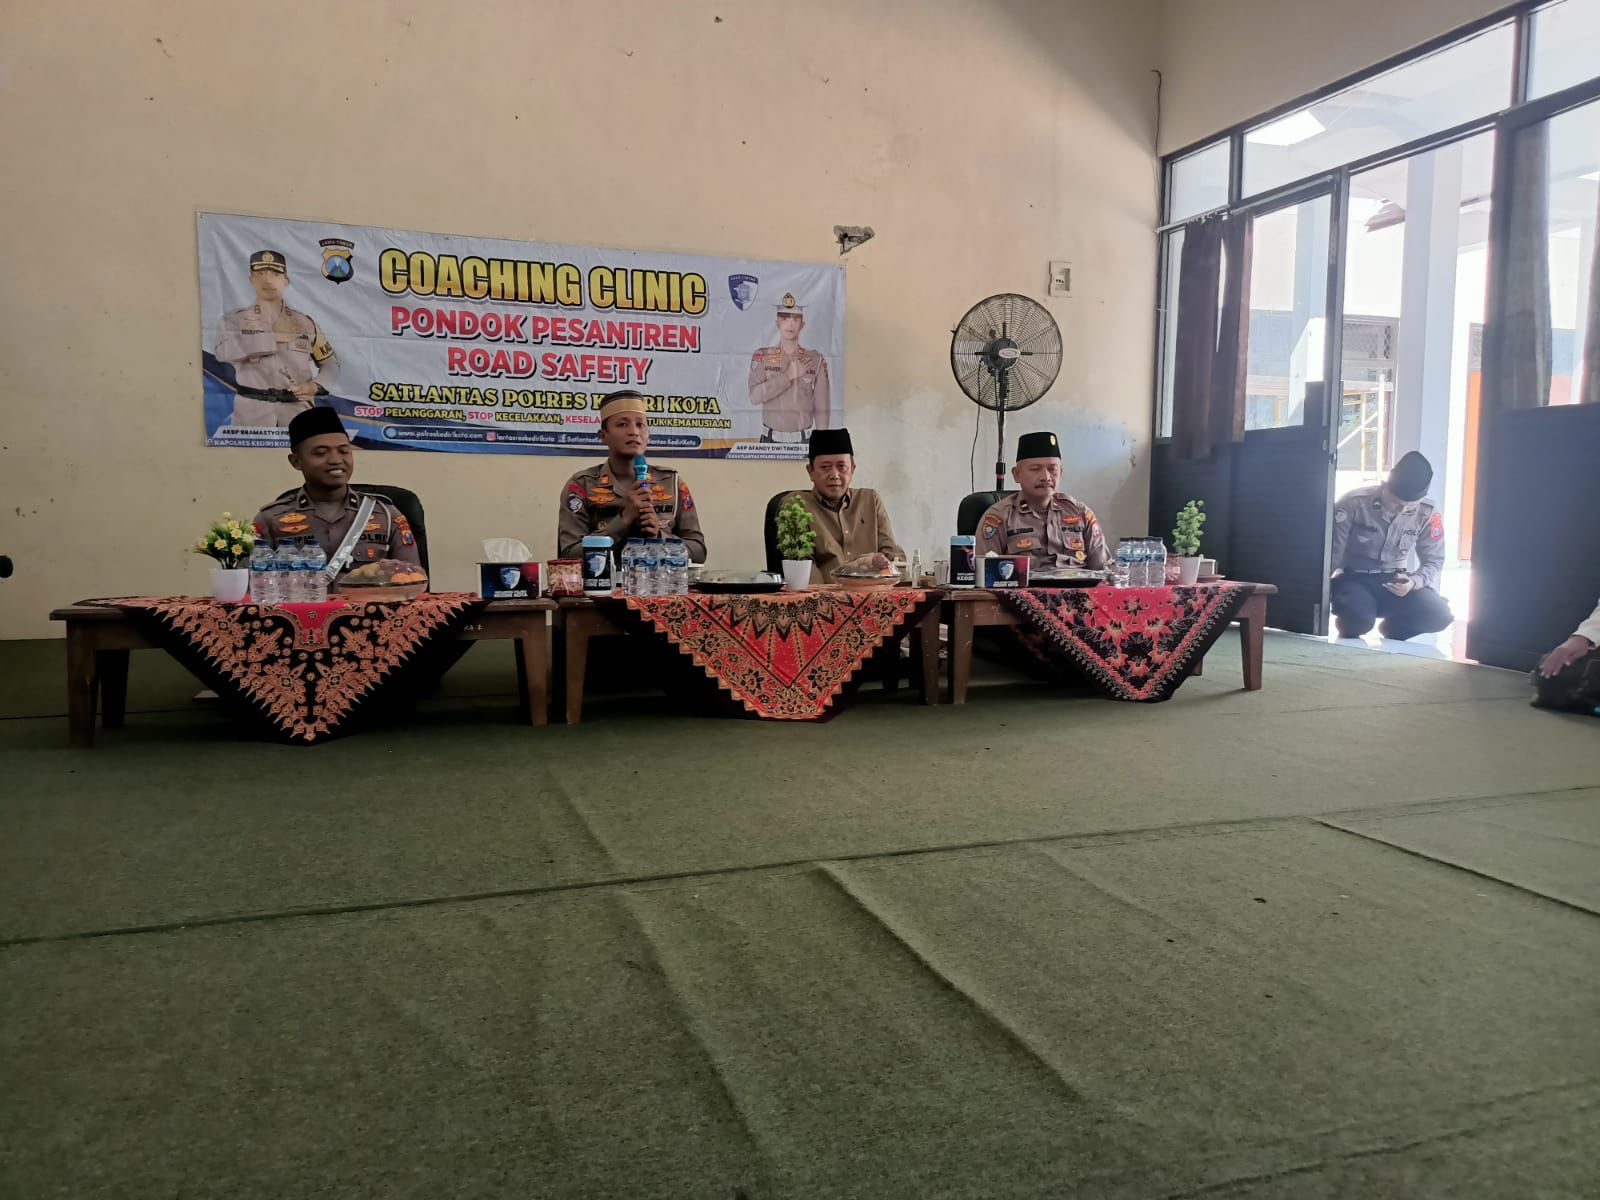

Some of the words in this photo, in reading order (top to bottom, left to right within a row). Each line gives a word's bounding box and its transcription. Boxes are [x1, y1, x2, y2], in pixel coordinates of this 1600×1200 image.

[379, 248, 583, 306] COACHING
[588, 265, 707, 315] CLINIC
[391, 305, 526, 341] PONDOK
[532, 315, 700, 352] PESANTREN
[447, 346, 536, 378] ROAD
[541, 352, 651, 383] SAFETY
[369, 383, 498, 406] SATLANTAS
[503, 389, 588, 410] POLRES
[591, 393, 664, 414] KRI
[668, 396, 721, 414] KOTA
[354, 406, 384, 417] STOP
[385, 407, 466, 421] PELANGGARAN,
[468, 411, 493, 420] STOP
[495, 411, 563, 425] KECELAKAAN,
[565, 415, 602, 424] KESELA
[647, 418, 665, 428] TUK
[666, 418, 731, 429] KEMANUSIAAN
